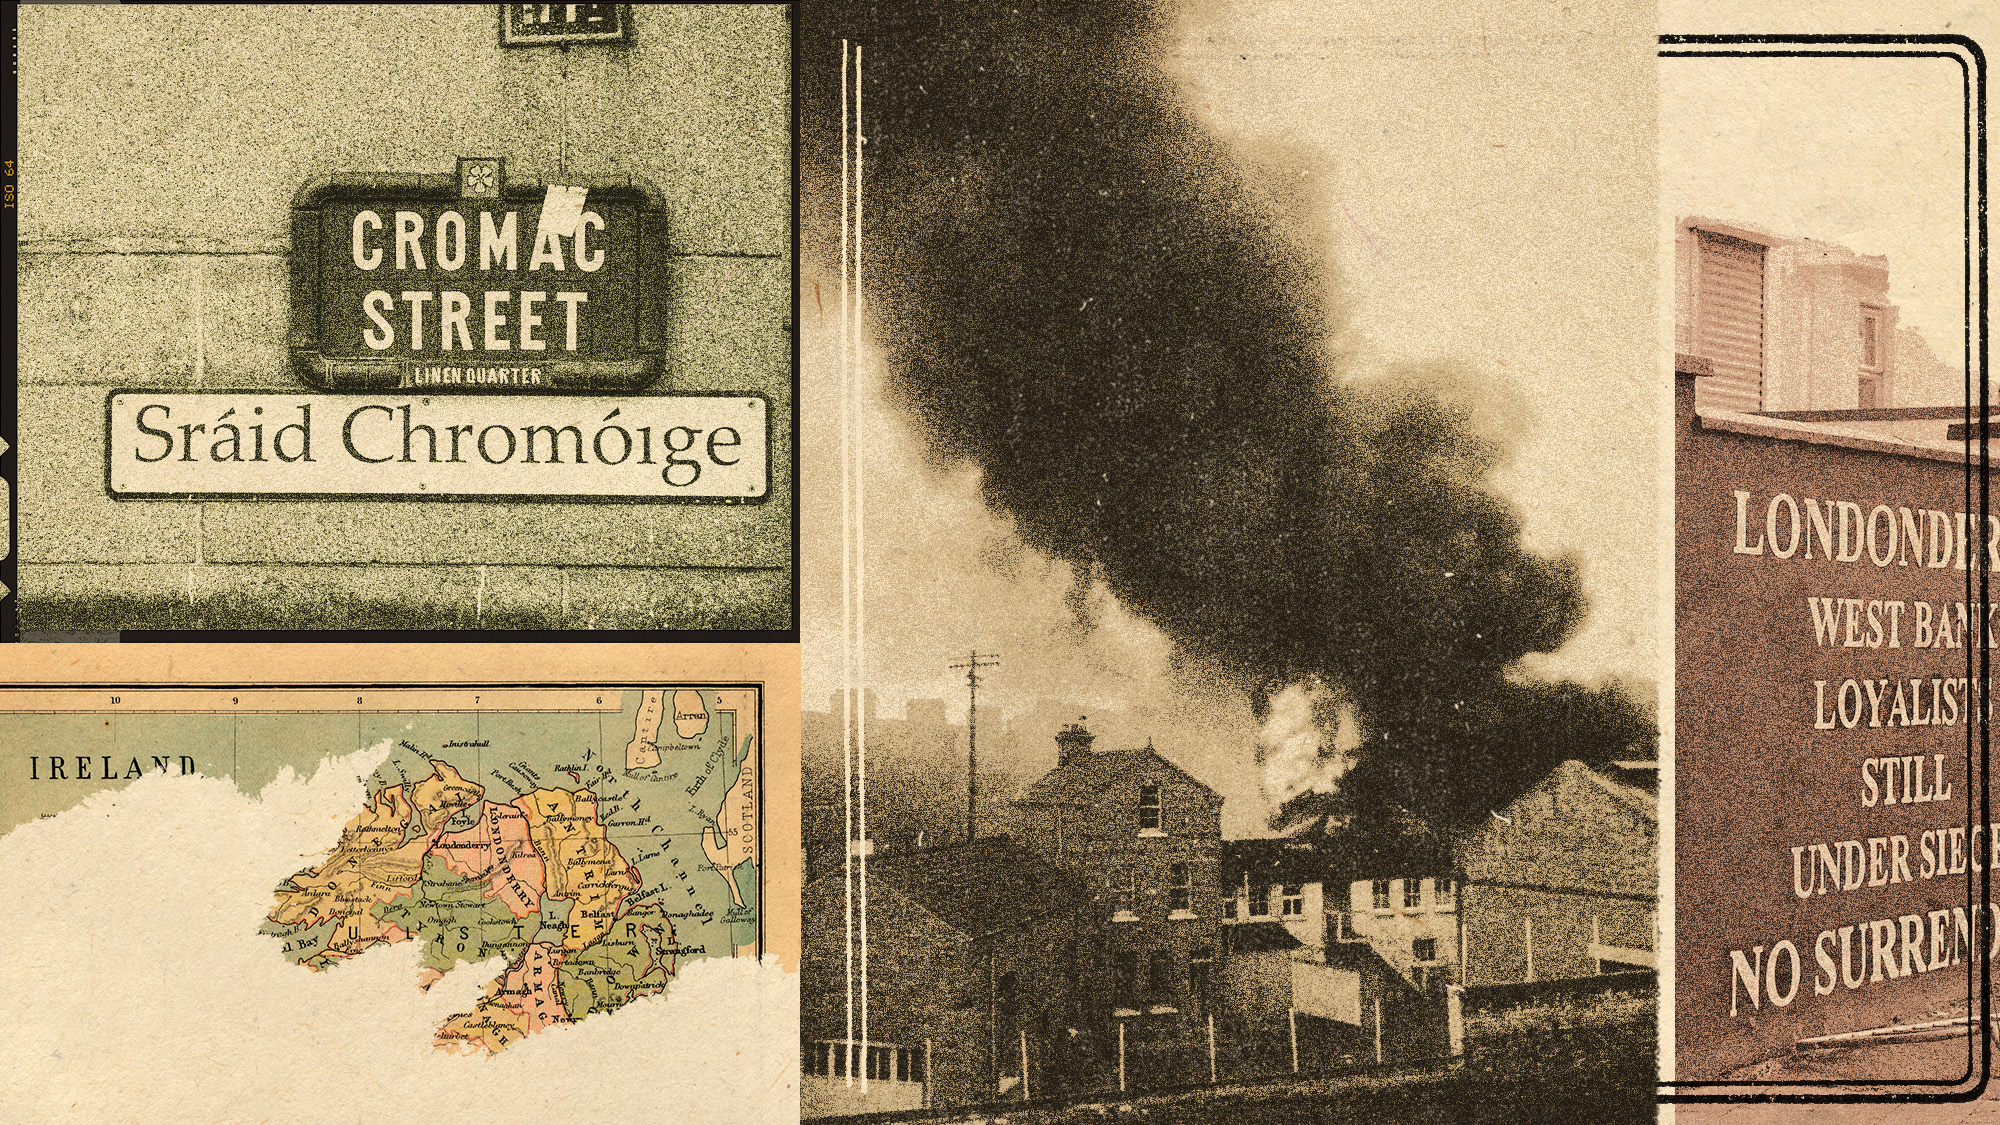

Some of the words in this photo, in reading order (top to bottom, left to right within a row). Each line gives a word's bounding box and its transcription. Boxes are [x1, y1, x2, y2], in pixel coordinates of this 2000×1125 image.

[4, 159, 14, 177] 64
[4, 184, 15, 209] ISO
[352, 210, 605, 272] CROMAC
[363, 290, 588, 350] STREET
[415, 367, 462, 384] LINEN
[466, 367, 542, 384] QUARTER
[136, 404, 317, 463] Sráid
[1808, 598, 1905, 649] WEST
[1913, 601, 1999, 649] BANK
[110, 696, 121, 705] 10
[232, 697, 239, 705] 9
[356, 696, 363, 705] 8
[474, 696, 481, 704] 7
[596, 696, 603, 704] 6
[716, 696, 723, 704] 5
[675, 711, 707, 720] Arran
[710, 736, 730, 763] Clyde
[554, 764, 582, 772] Rathlin
[1861, 754, 1951, 808] STILL
[575, 794, 623, 805] Ballycastle
[741, 767, 754, 854] SCOTLAND
[451, 816, 476, 827] Foyle
[728, 828, 739, 836] 55
[435, 840, 492, 852] Londonderry
[490, 807, 535, 908] LONDONDERRY
[1791, 834, 1913, 899] UNDER
[651, 825, 713, 926] Channel
[625, 887, 660, 908] Belfast
[420, 901, 455, 909] Newtown
[455, 901, 487, 909] Stewart
[581, 910, 615, 919] Belfast
[661, 909, 715, 920] Donaghadee
[540, 921, 570, 932] Neagh
[299, 935, 319, 951] Bay
[1729, 940, 1801, 1017] NO
[496, 986, 532, 998] Armagh
